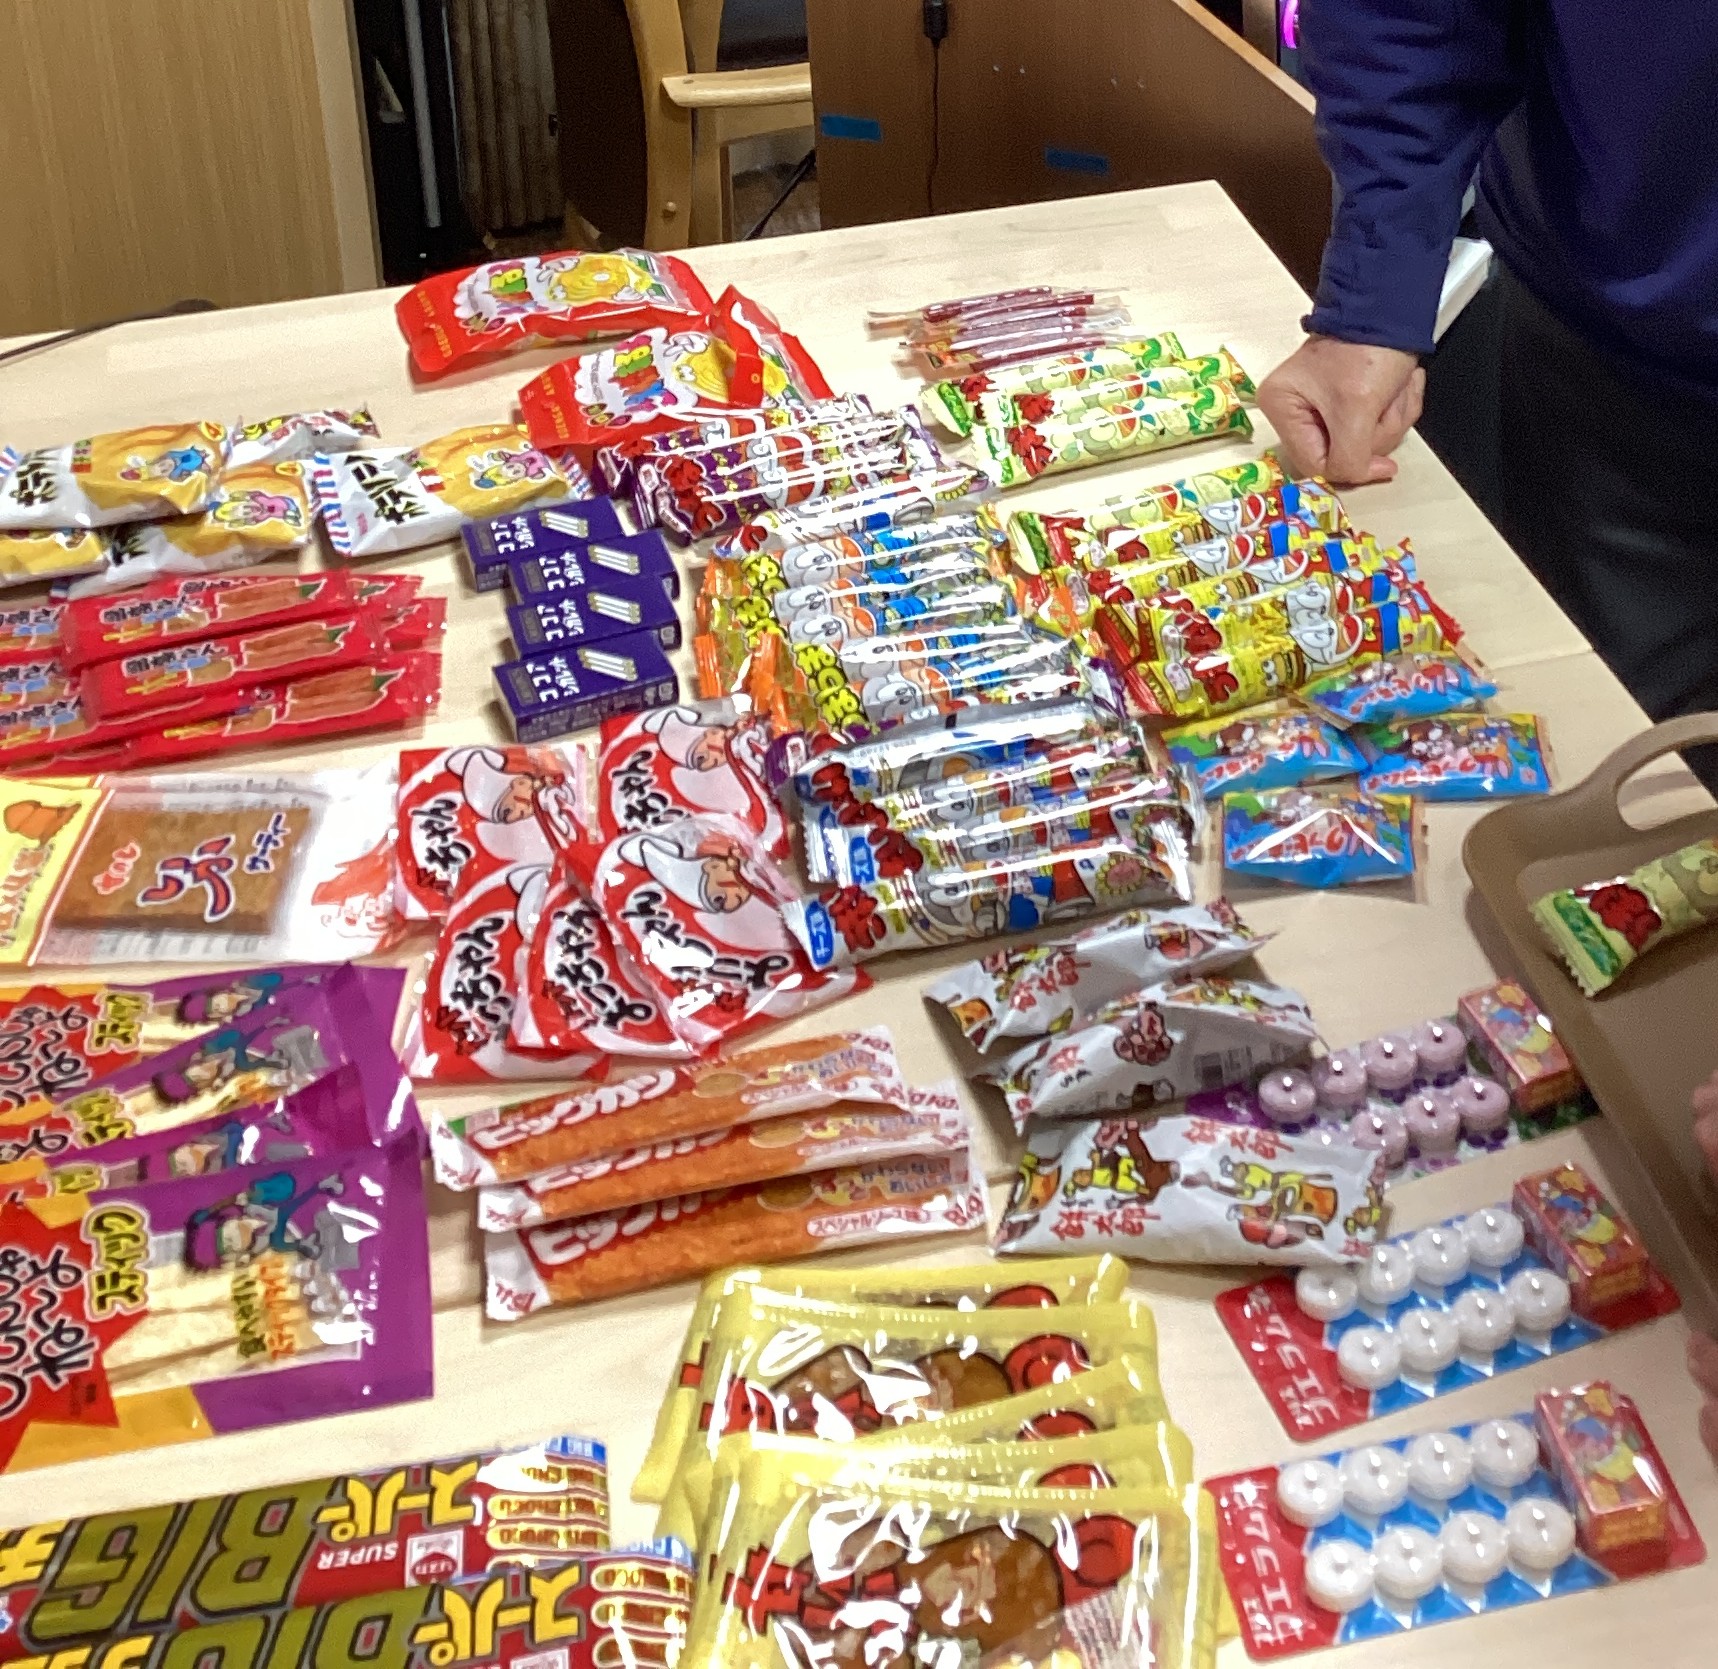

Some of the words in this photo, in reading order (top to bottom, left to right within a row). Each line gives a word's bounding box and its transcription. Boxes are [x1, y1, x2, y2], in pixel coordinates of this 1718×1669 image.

[490, 521, 515, 555] ココア
[538, 556, 566, 592] ココア
[536, 603, 564, 642] ココア
[525, 661, 560, 703] ココア
[472, 1069, 678, 1150] ビッグカツ
[1049, 1203, 1162, 1242] 餅太郎
[90, 1207, 146, 1313] スティック
[1246, 1286, 1341, 1428] フエラムネ
[317, 1459, 481, 1541] スーパー
[22, 1477, 333, 1646] BIG
[316, 1542, 398, 1571] SUPER
[410, 1561, 580, 1666] スーパー
